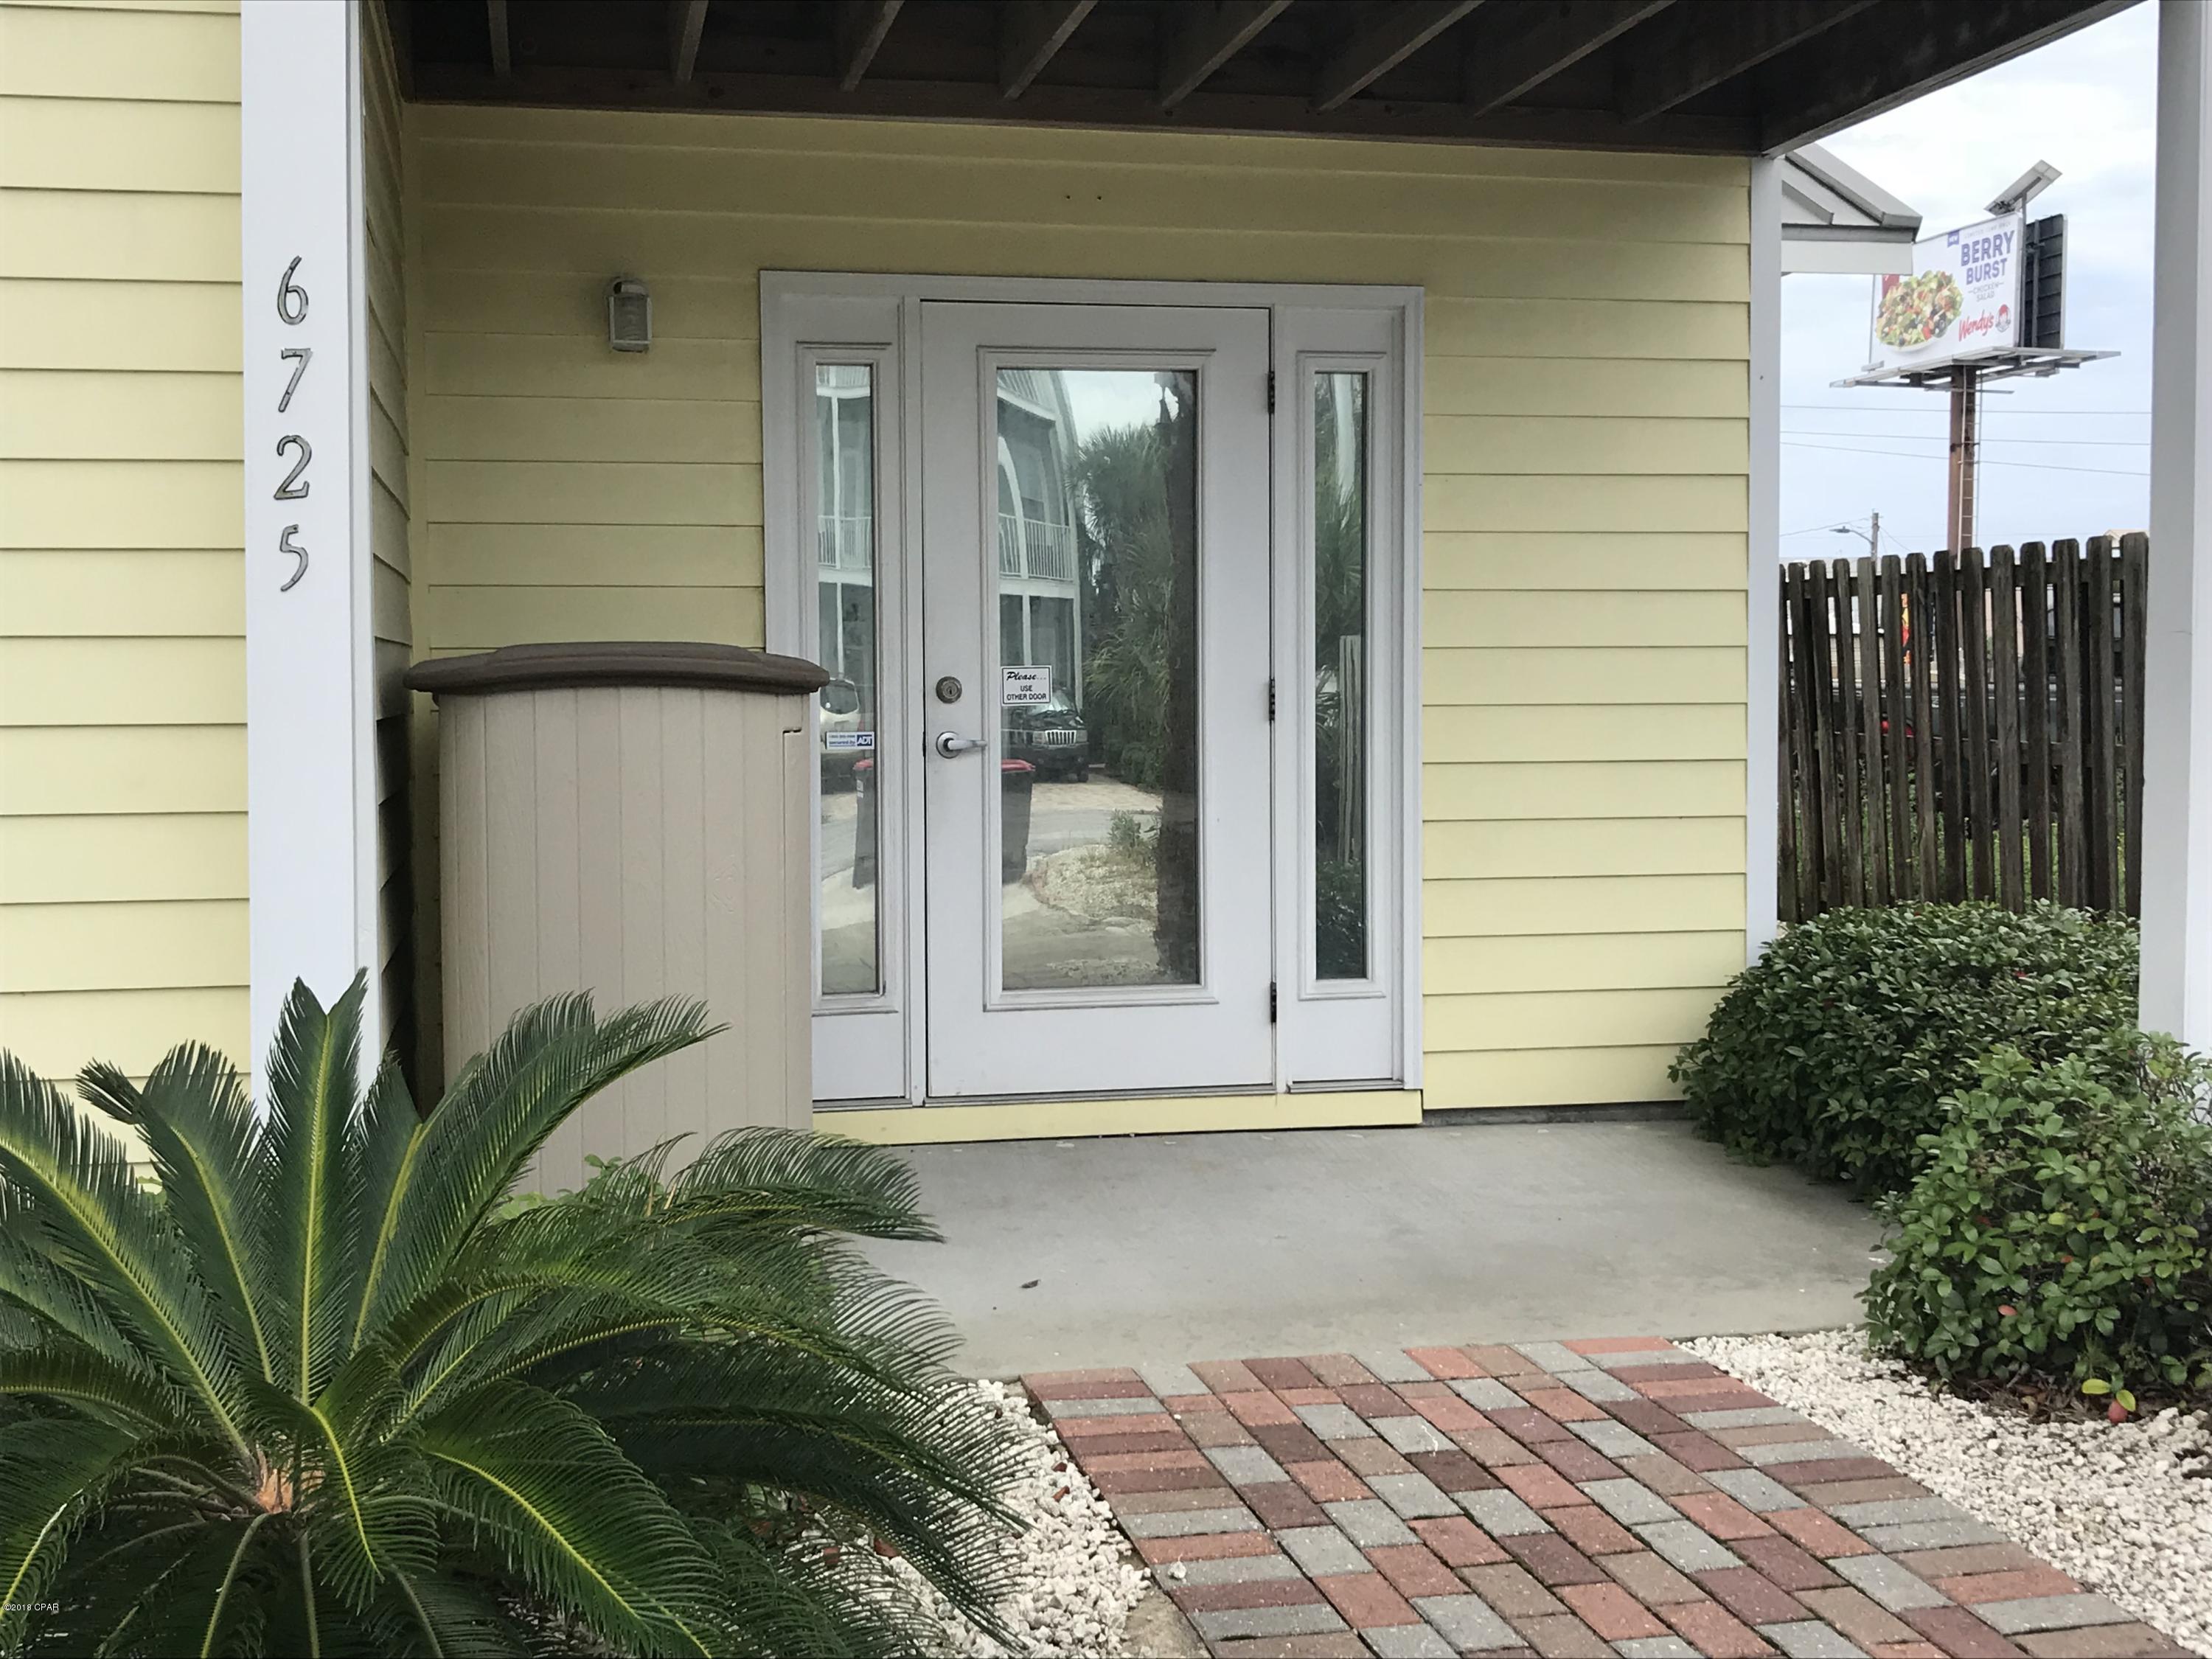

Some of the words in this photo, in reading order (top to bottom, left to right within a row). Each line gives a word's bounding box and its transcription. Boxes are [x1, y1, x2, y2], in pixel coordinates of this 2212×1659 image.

[1961, 230, 2015, 266] BERRY
[1966, 257, 2007, 285] BURST
[1958, 309, 1994, 342] Wendy's
[274, 255, 313, 592] 6725
[858, 736, 873, 745] ADT
